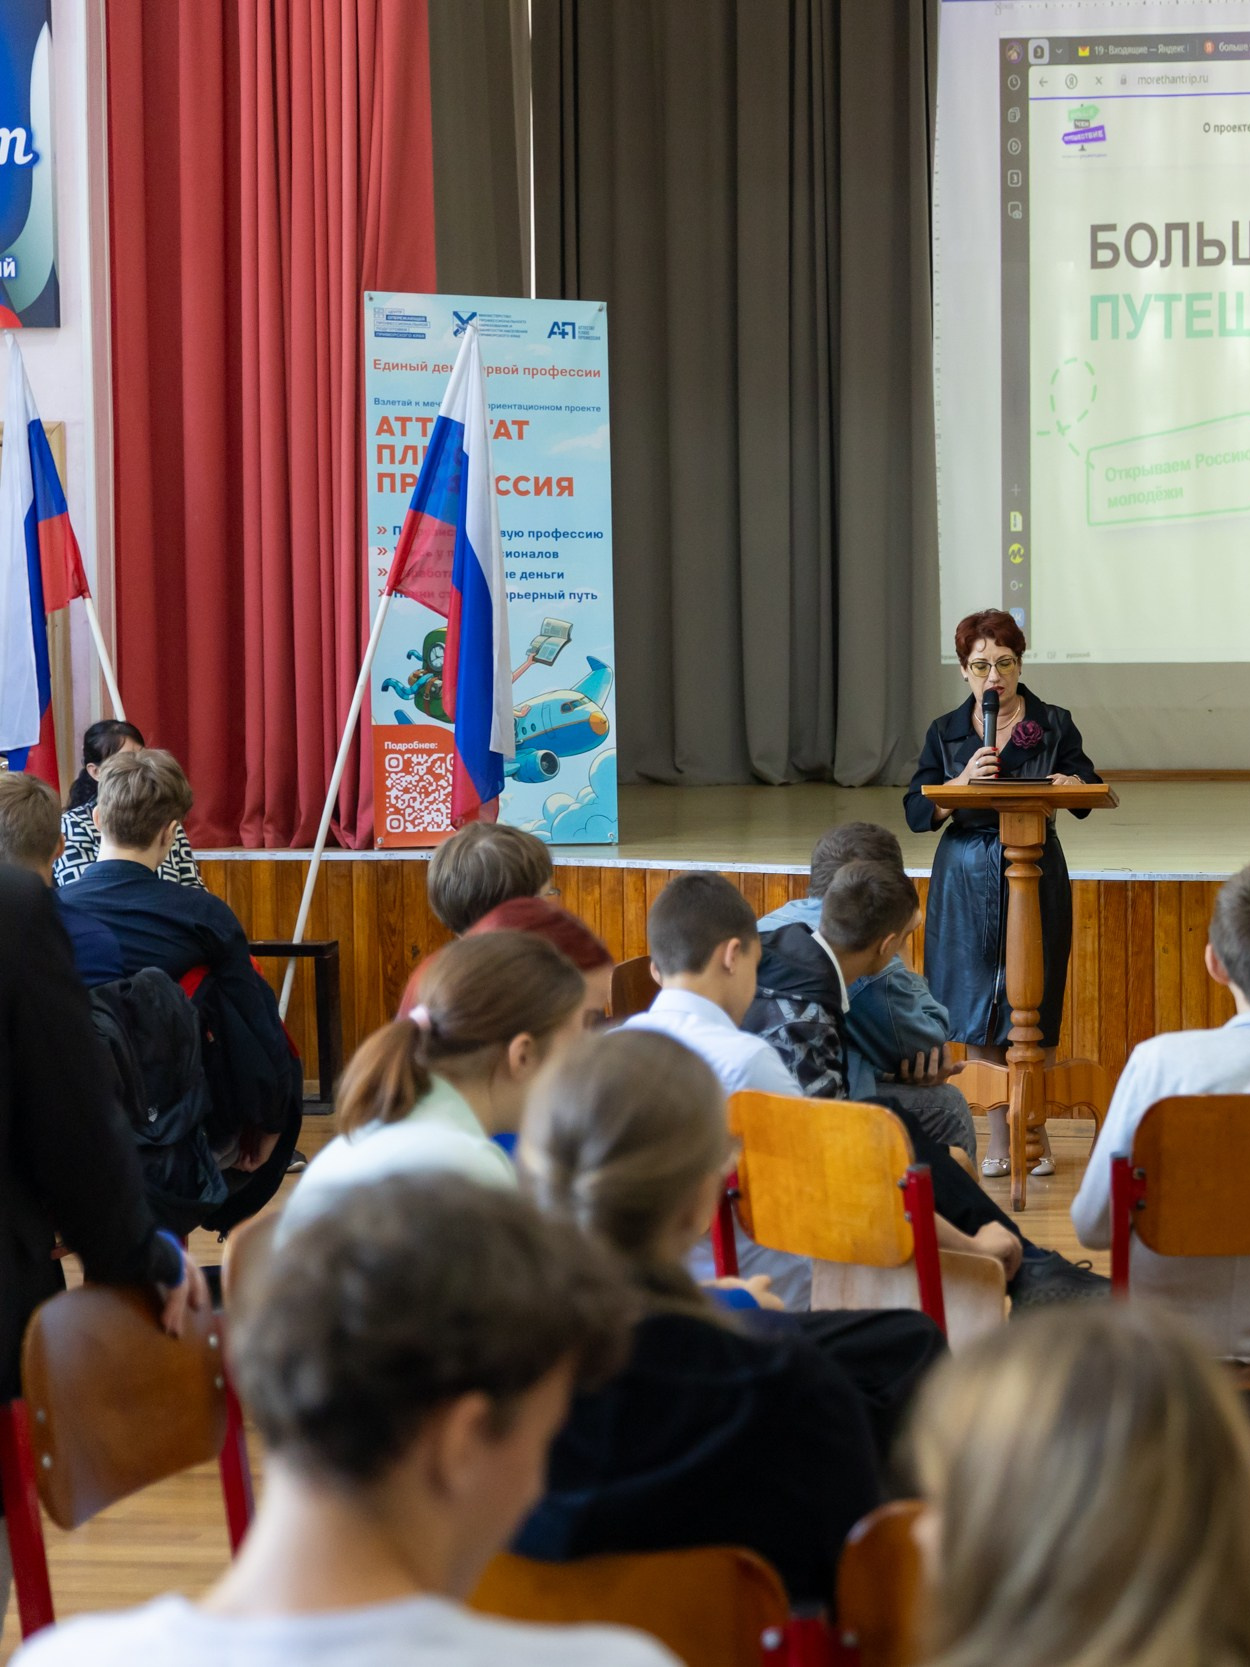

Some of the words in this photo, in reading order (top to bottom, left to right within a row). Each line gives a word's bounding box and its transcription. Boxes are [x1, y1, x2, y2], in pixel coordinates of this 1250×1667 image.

[1219, 42, 1249, 52] больше
[1137, 73, 1209, 86] morethantrip.ru
[1203, 122, 1211, 133] О
[373, 358, 429, 373] Единый
[483, 364, 520, 377] рвой
[523, 364, 601, 380] профессии
[374, 397, 413, 407] Взлетай
[564, 405, 601, 414] проекте
[375, 415, 530, 441] АТТАТ
[1105, 457, 1191, 483] Открываем
[376, 472, 575, 497] ПРССИЯ
[528, 527, 604, 542] профессию
[520, 570, 564, 581] деньги
[505, 589, 565, 603] рьерный
[569, 591, 598, 604] путь
[384, 741, 439, 752] Подробнее:
